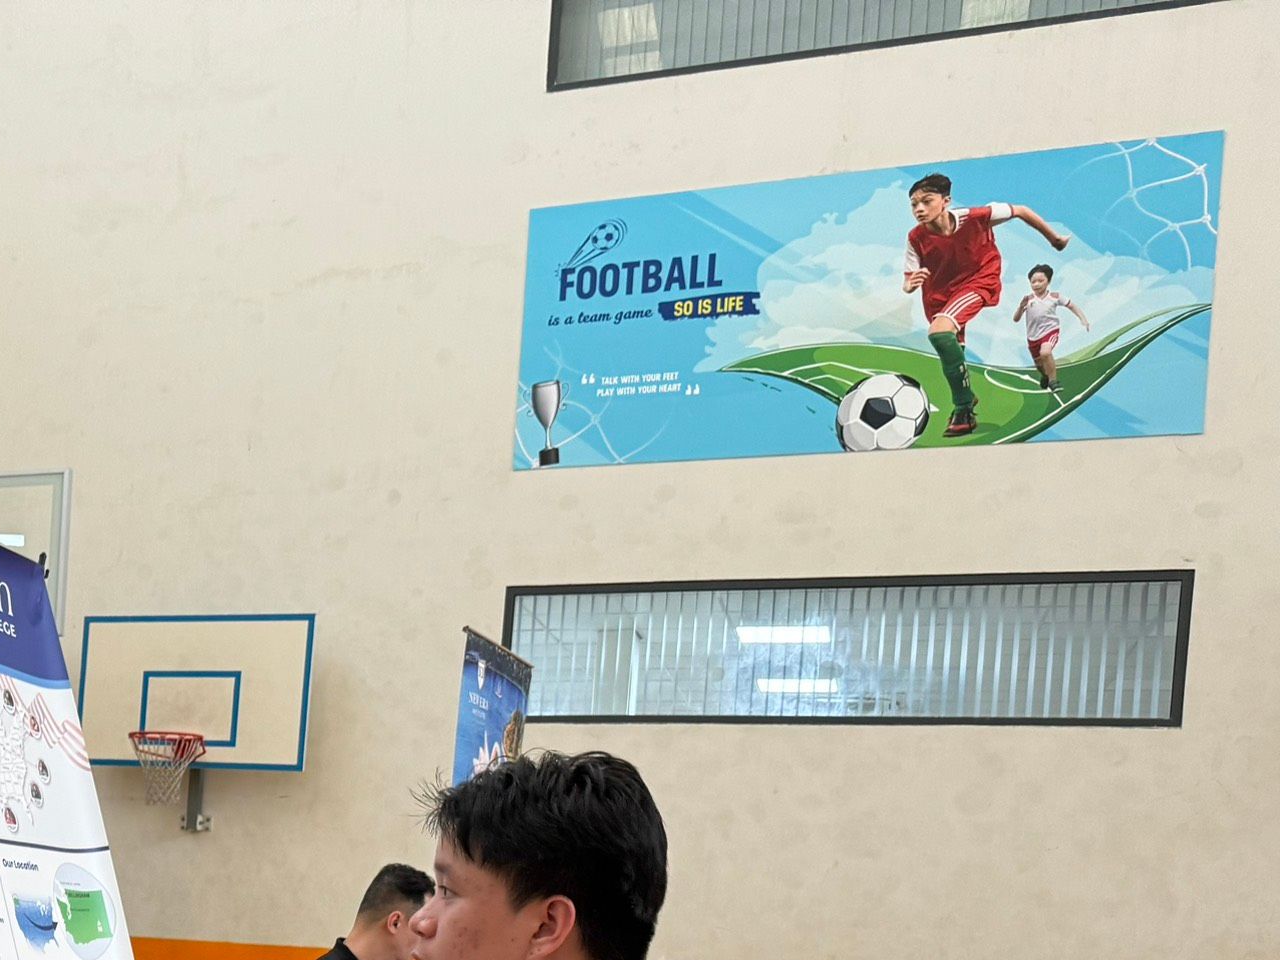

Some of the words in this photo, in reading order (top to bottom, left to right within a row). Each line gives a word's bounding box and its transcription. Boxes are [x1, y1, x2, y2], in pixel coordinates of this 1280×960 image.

[558, 253, 723, 302] FOOTBALL
[673, 300, 694, 318] SO
[697, 299, 712, 315] IS
[716, 295, 745, 313] LIFE
[547, 314, 560, 327] is
[564, 316, 574, 326] a
[577, 311, 613, 324] team
[613, 309, 654, 325] game
[601, 374, 618, 385] TALK
[619, 373, 640, 384] WITH
[641, 373, 662, 384] YOUR
[662, 371, 679, 382] FEET
[596, 387, 614, 397] PLAY
[616, 386, 636, 396] WITH
[637, 385, 657, 395] YOUR
[658, 383, 682, 393] HEART
[2, 858, 13, 868] Our
[13, 860, 39, 872] Location
